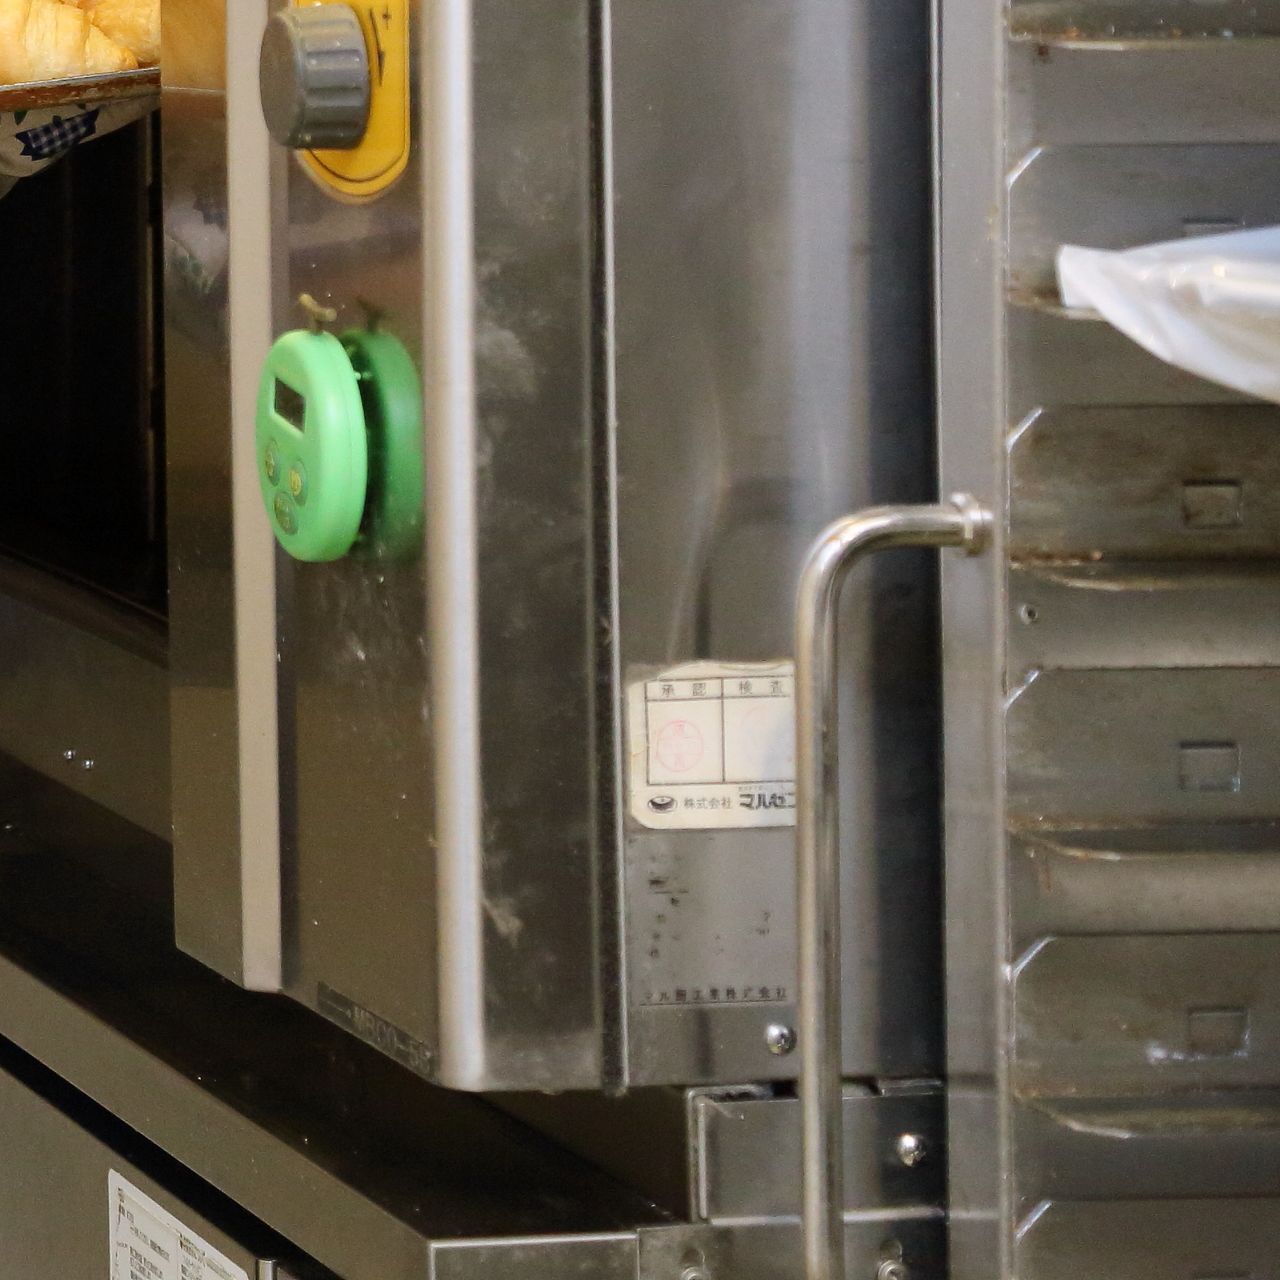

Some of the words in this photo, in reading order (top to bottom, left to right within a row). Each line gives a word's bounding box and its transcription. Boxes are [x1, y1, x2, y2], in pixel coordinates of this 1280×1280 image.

[661, 683, 707, 697] 承認
[738, 681, 785, 695] 検査
[684, 797, 732, 809] 株式会社
